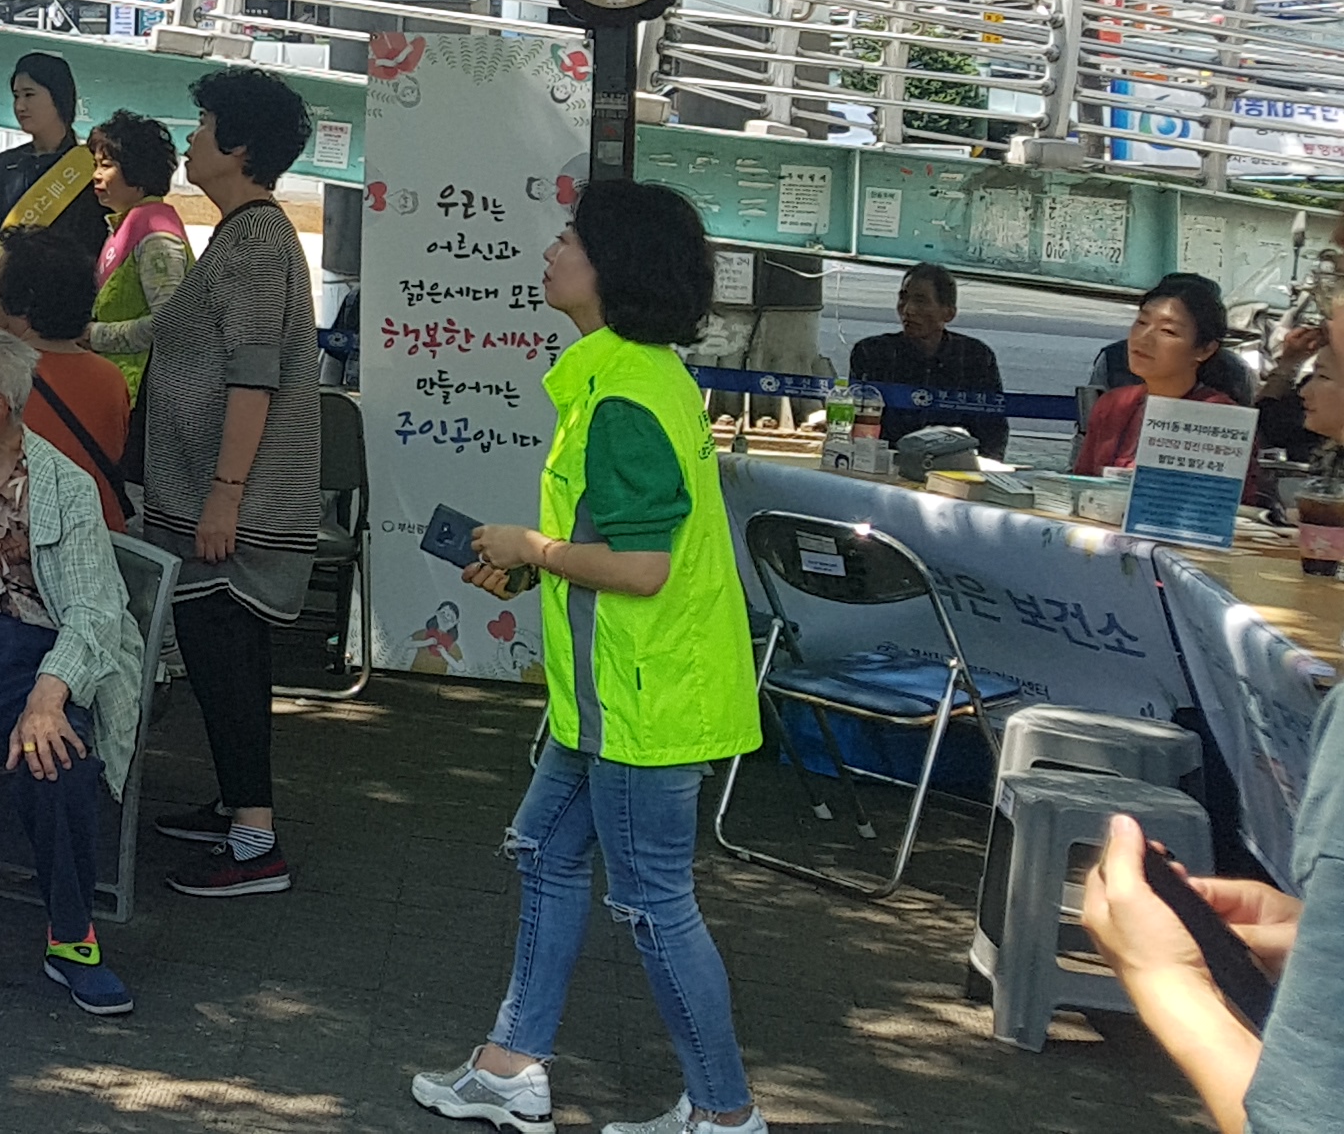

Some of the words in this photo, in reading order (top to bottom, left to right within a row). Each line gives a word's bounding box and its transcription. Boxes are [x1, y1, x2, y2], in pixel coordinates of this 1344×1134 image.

[437, 185, 506, 221] 우리는
[427, 232, 521, 261] 어르신과
[399, 280, 500, 307] 젊은세대
[508, 285, 545, 312] 모두
[381, 318, 476, 359] 행복한
[482, 332, 562, 367] 세상을
[417, 369, 521, 408] 만들어가는
[395, 411, 543, 454] 주인공입니다
[1006, 589, 1146, 658] 보건소
